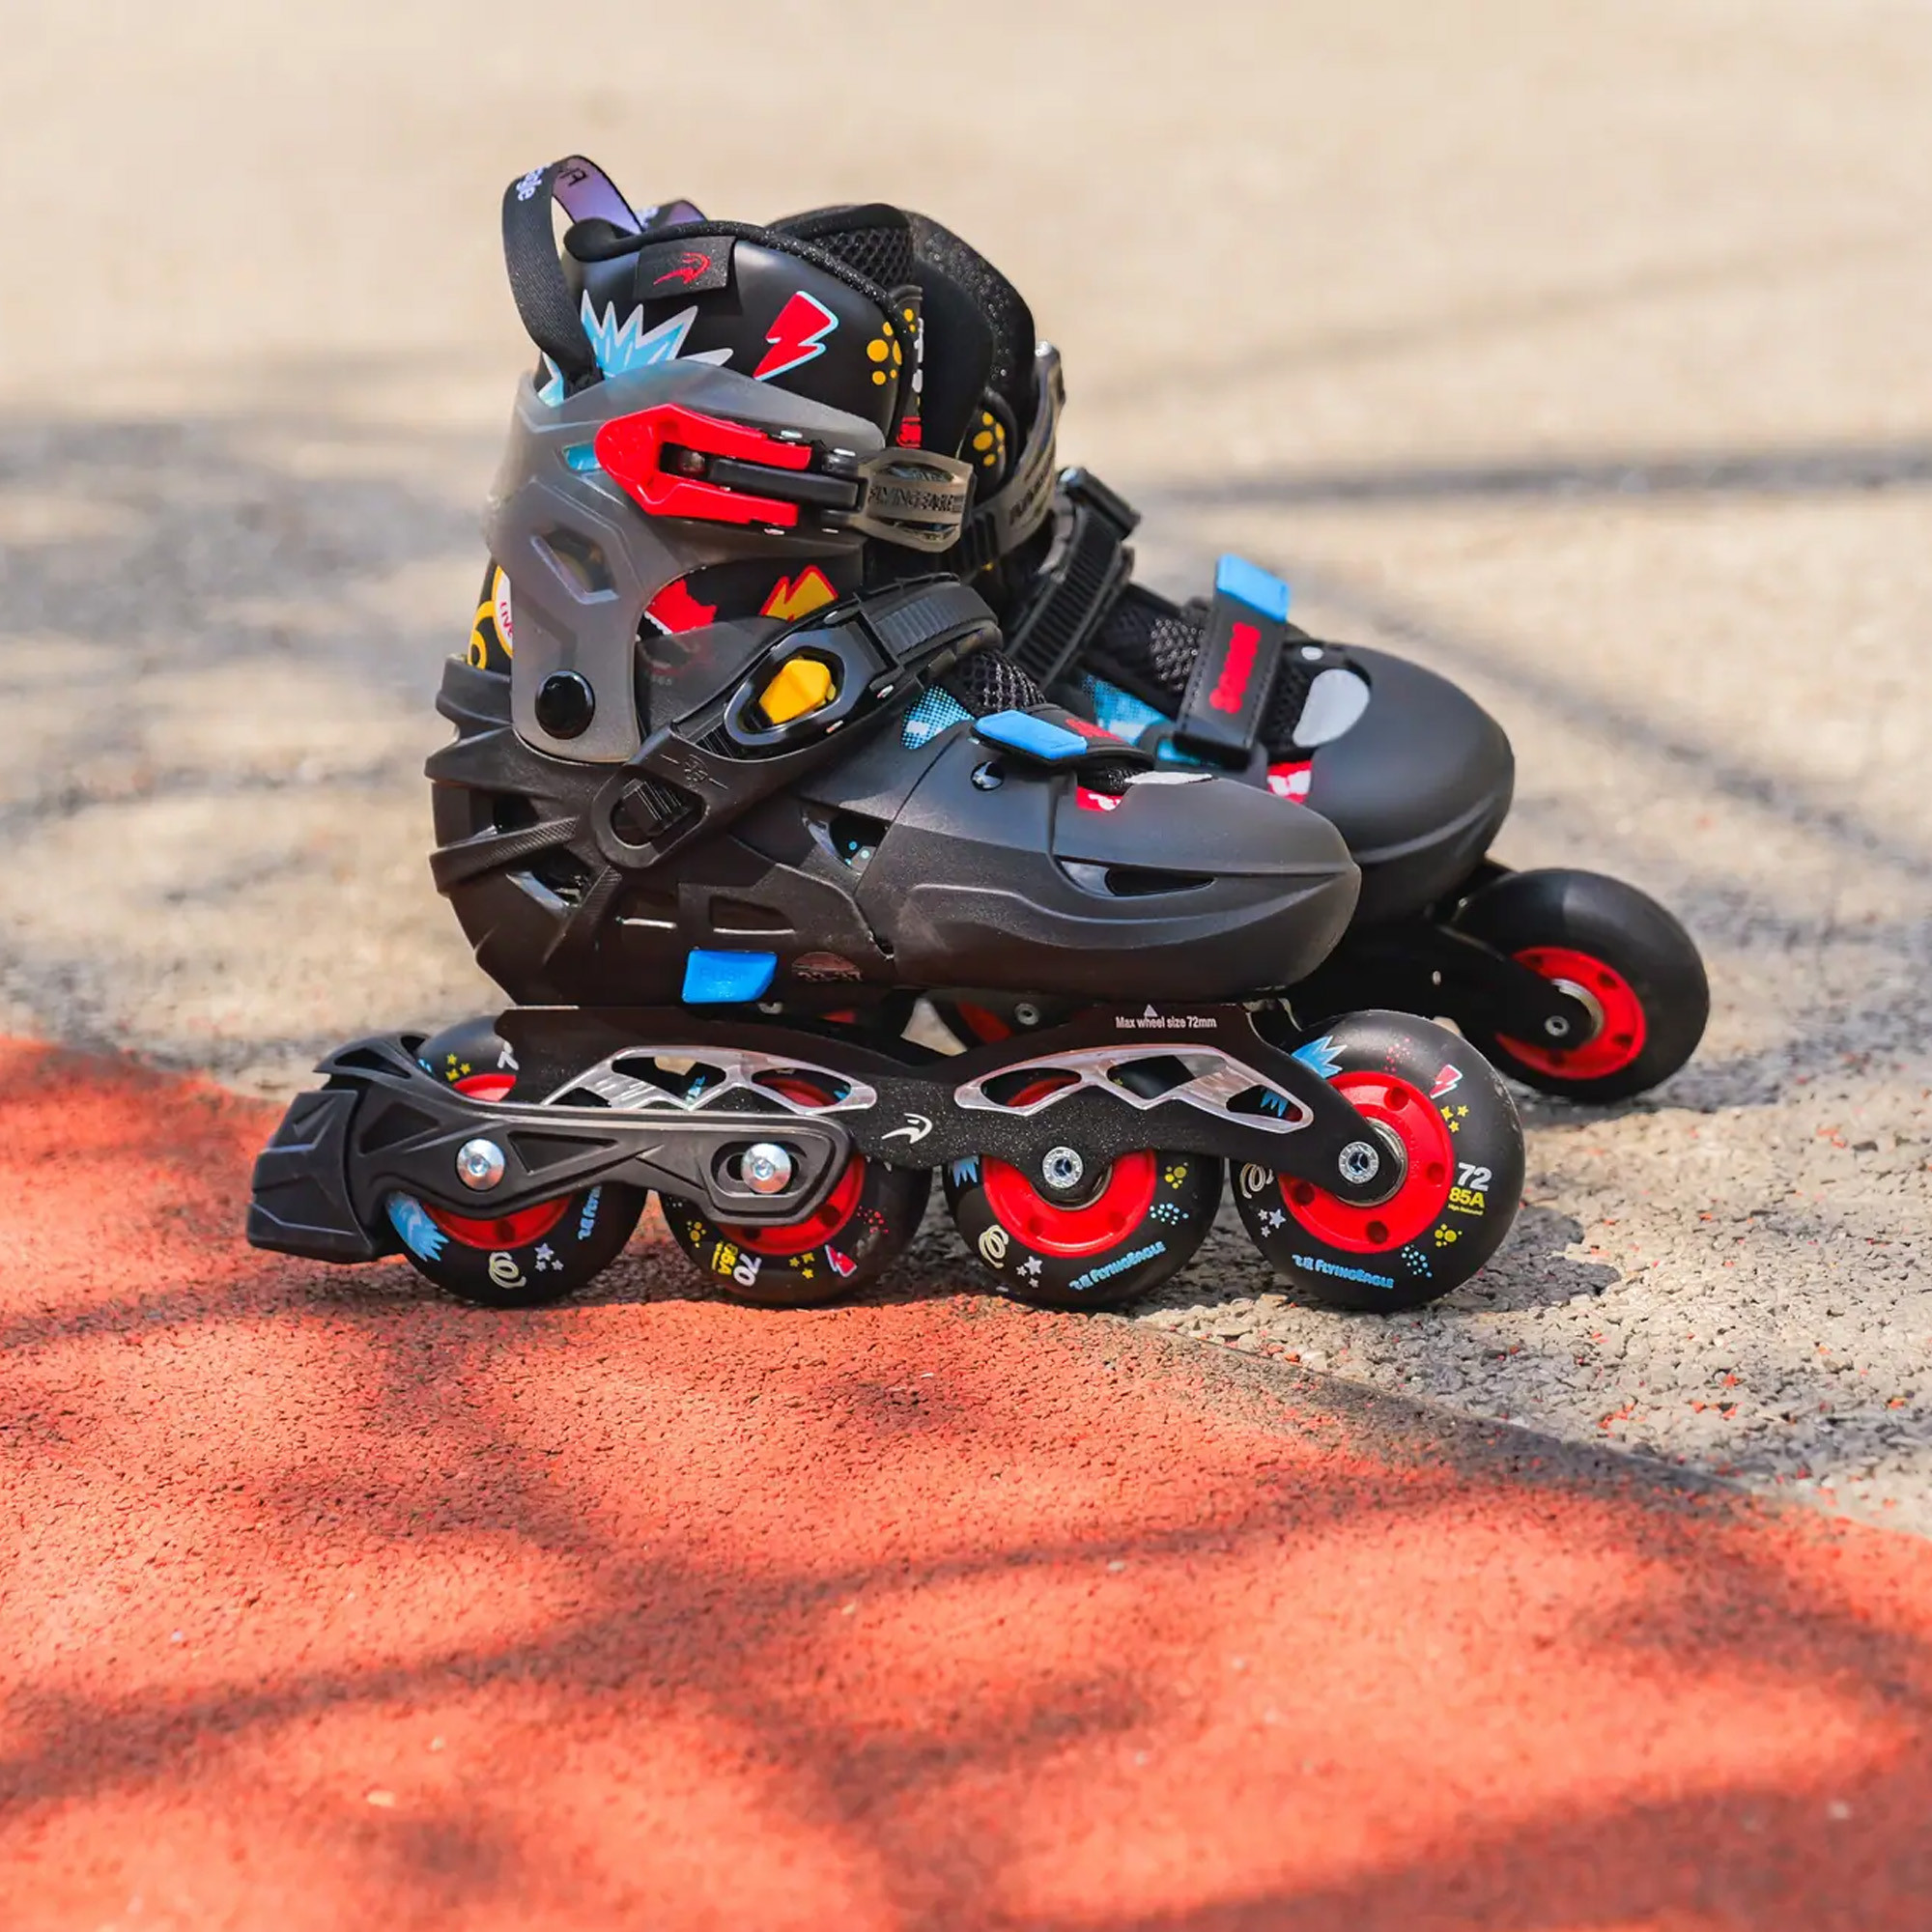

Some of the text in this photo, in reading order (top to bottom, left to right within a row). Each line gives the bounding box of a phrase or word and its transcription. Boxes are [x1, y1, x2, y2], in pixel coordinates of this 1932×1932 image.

[1115, 1016, 1217, 1029] Max wheel size 72mm
[1457, 1162, 1492, 1191] 72
[1449, 1186, 1485, 1208] 85A
[733, 1253, 762, 1287] 70
